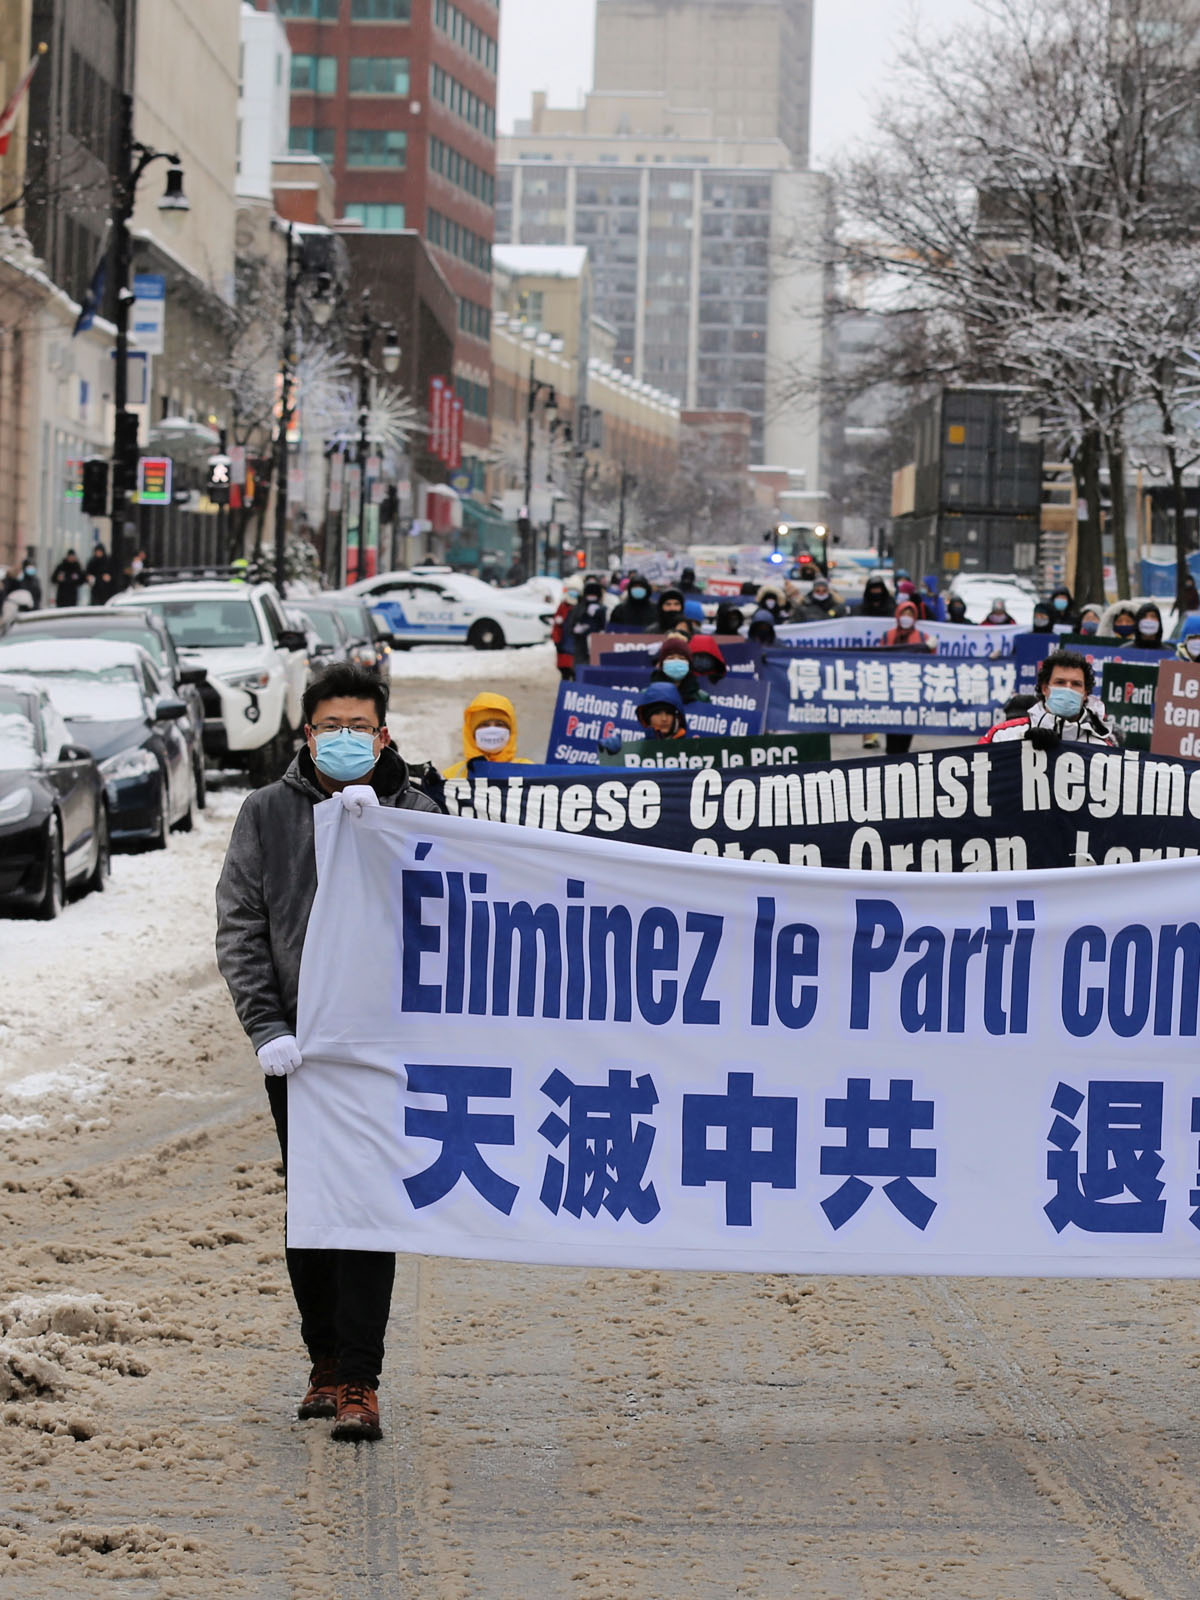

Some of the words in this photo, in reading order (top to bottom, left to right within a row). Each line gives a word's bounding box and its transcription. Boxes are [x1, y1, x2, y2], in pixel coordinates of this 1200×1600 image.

[417, 611, 454, 621] POLICE
[1108, 681, 1123, 703] Le
[1124, 681, 1153, 705] Parti
[1172, 672, 1199, 699] Le
[563, 690, 618, 718] Mettons
[730, 716, 749, 737] du
[828, 704, 839, 723] la
[904, 706, 918, 725] du
[919, 706, 948, 727] Falun
[950, 708, 977, 731] Gong
[566, 715, 602, 740] Parti
[442, 776, 661, 833] Chinese
[689, 751, 993, 830] Communist
[401, 842, 724, 1026] Éliminez
[751, 896, 819, 1030] le
[850, 899, 1035, 1036] Parti
[402, 1063, 939, 1231] 天滅中共
